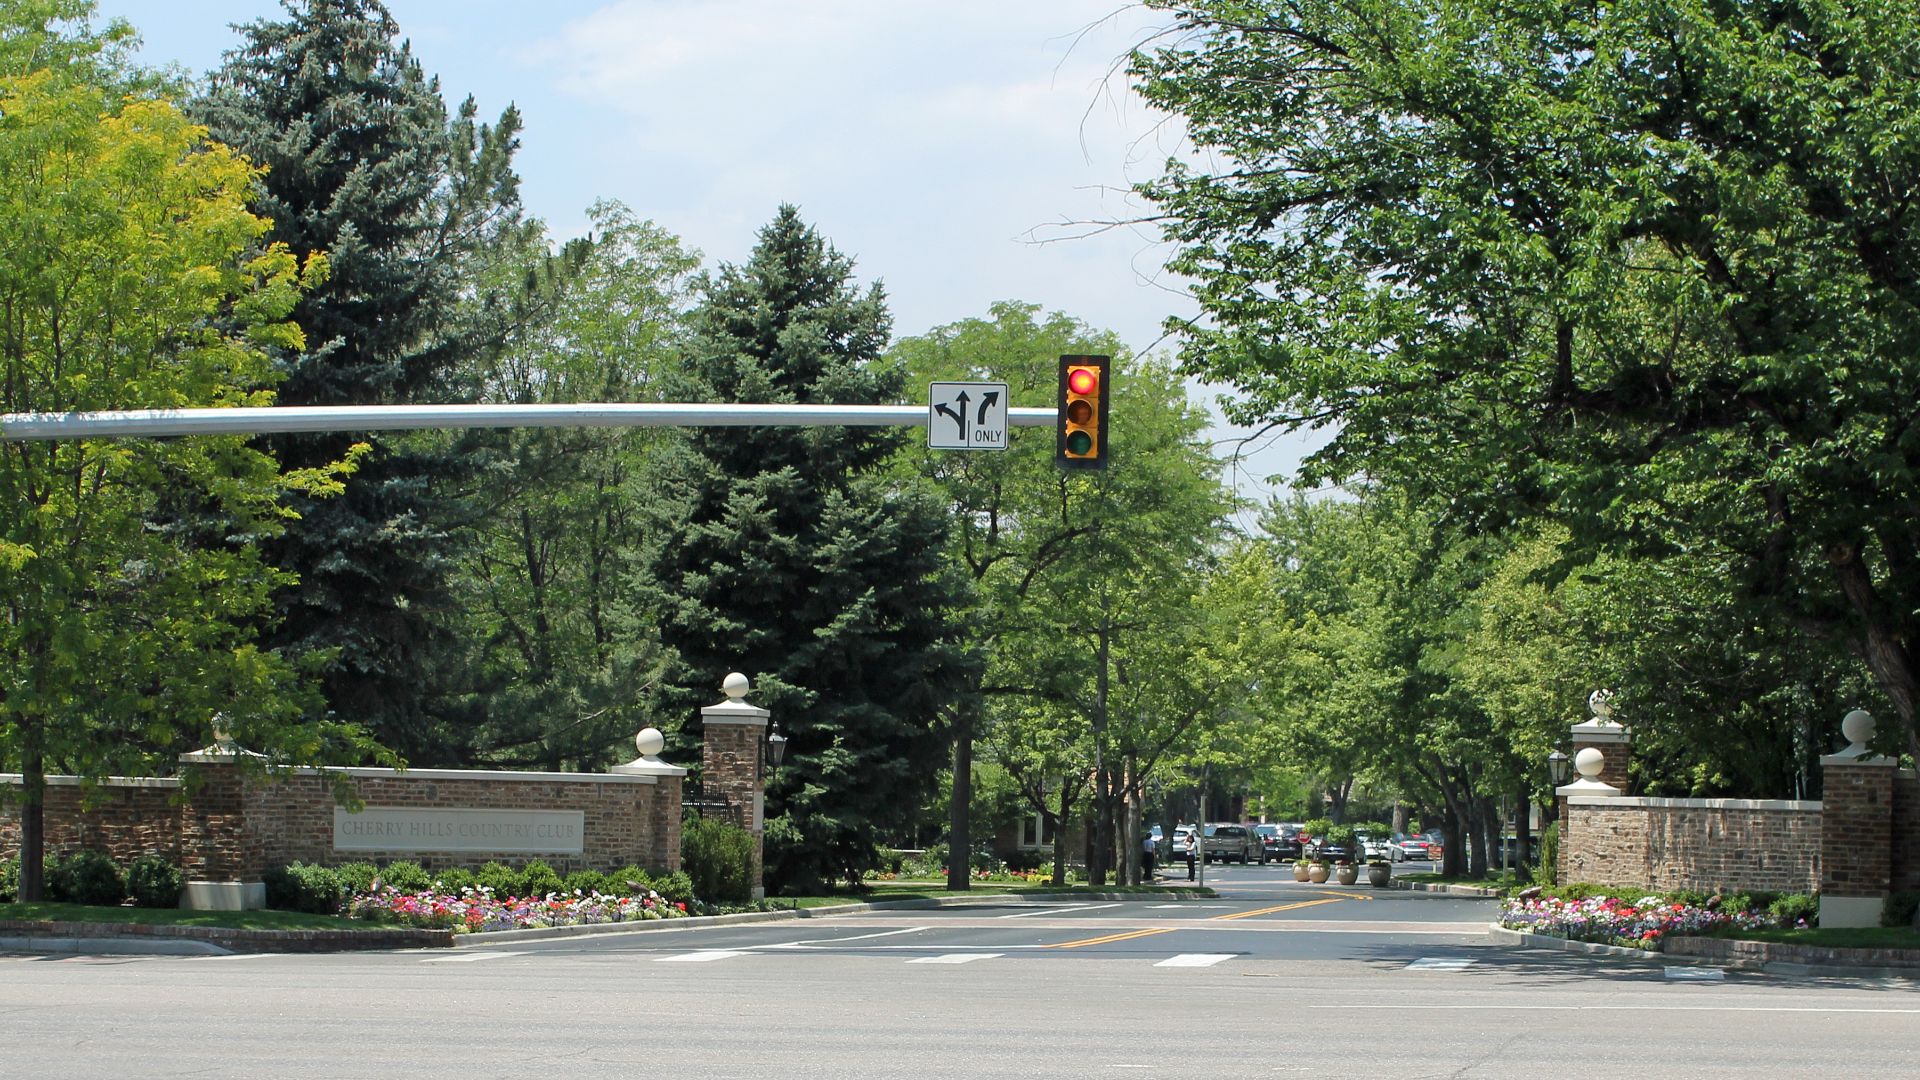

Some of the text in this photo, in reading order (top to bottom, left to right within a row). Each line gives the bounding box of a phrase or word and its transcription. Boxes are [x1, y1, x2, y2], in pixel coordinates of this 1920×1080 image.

[975, 430, 1002, 443] ONLY
[342, 821, 575, 839] CHERRY HILLS COUNTRY CLUB
